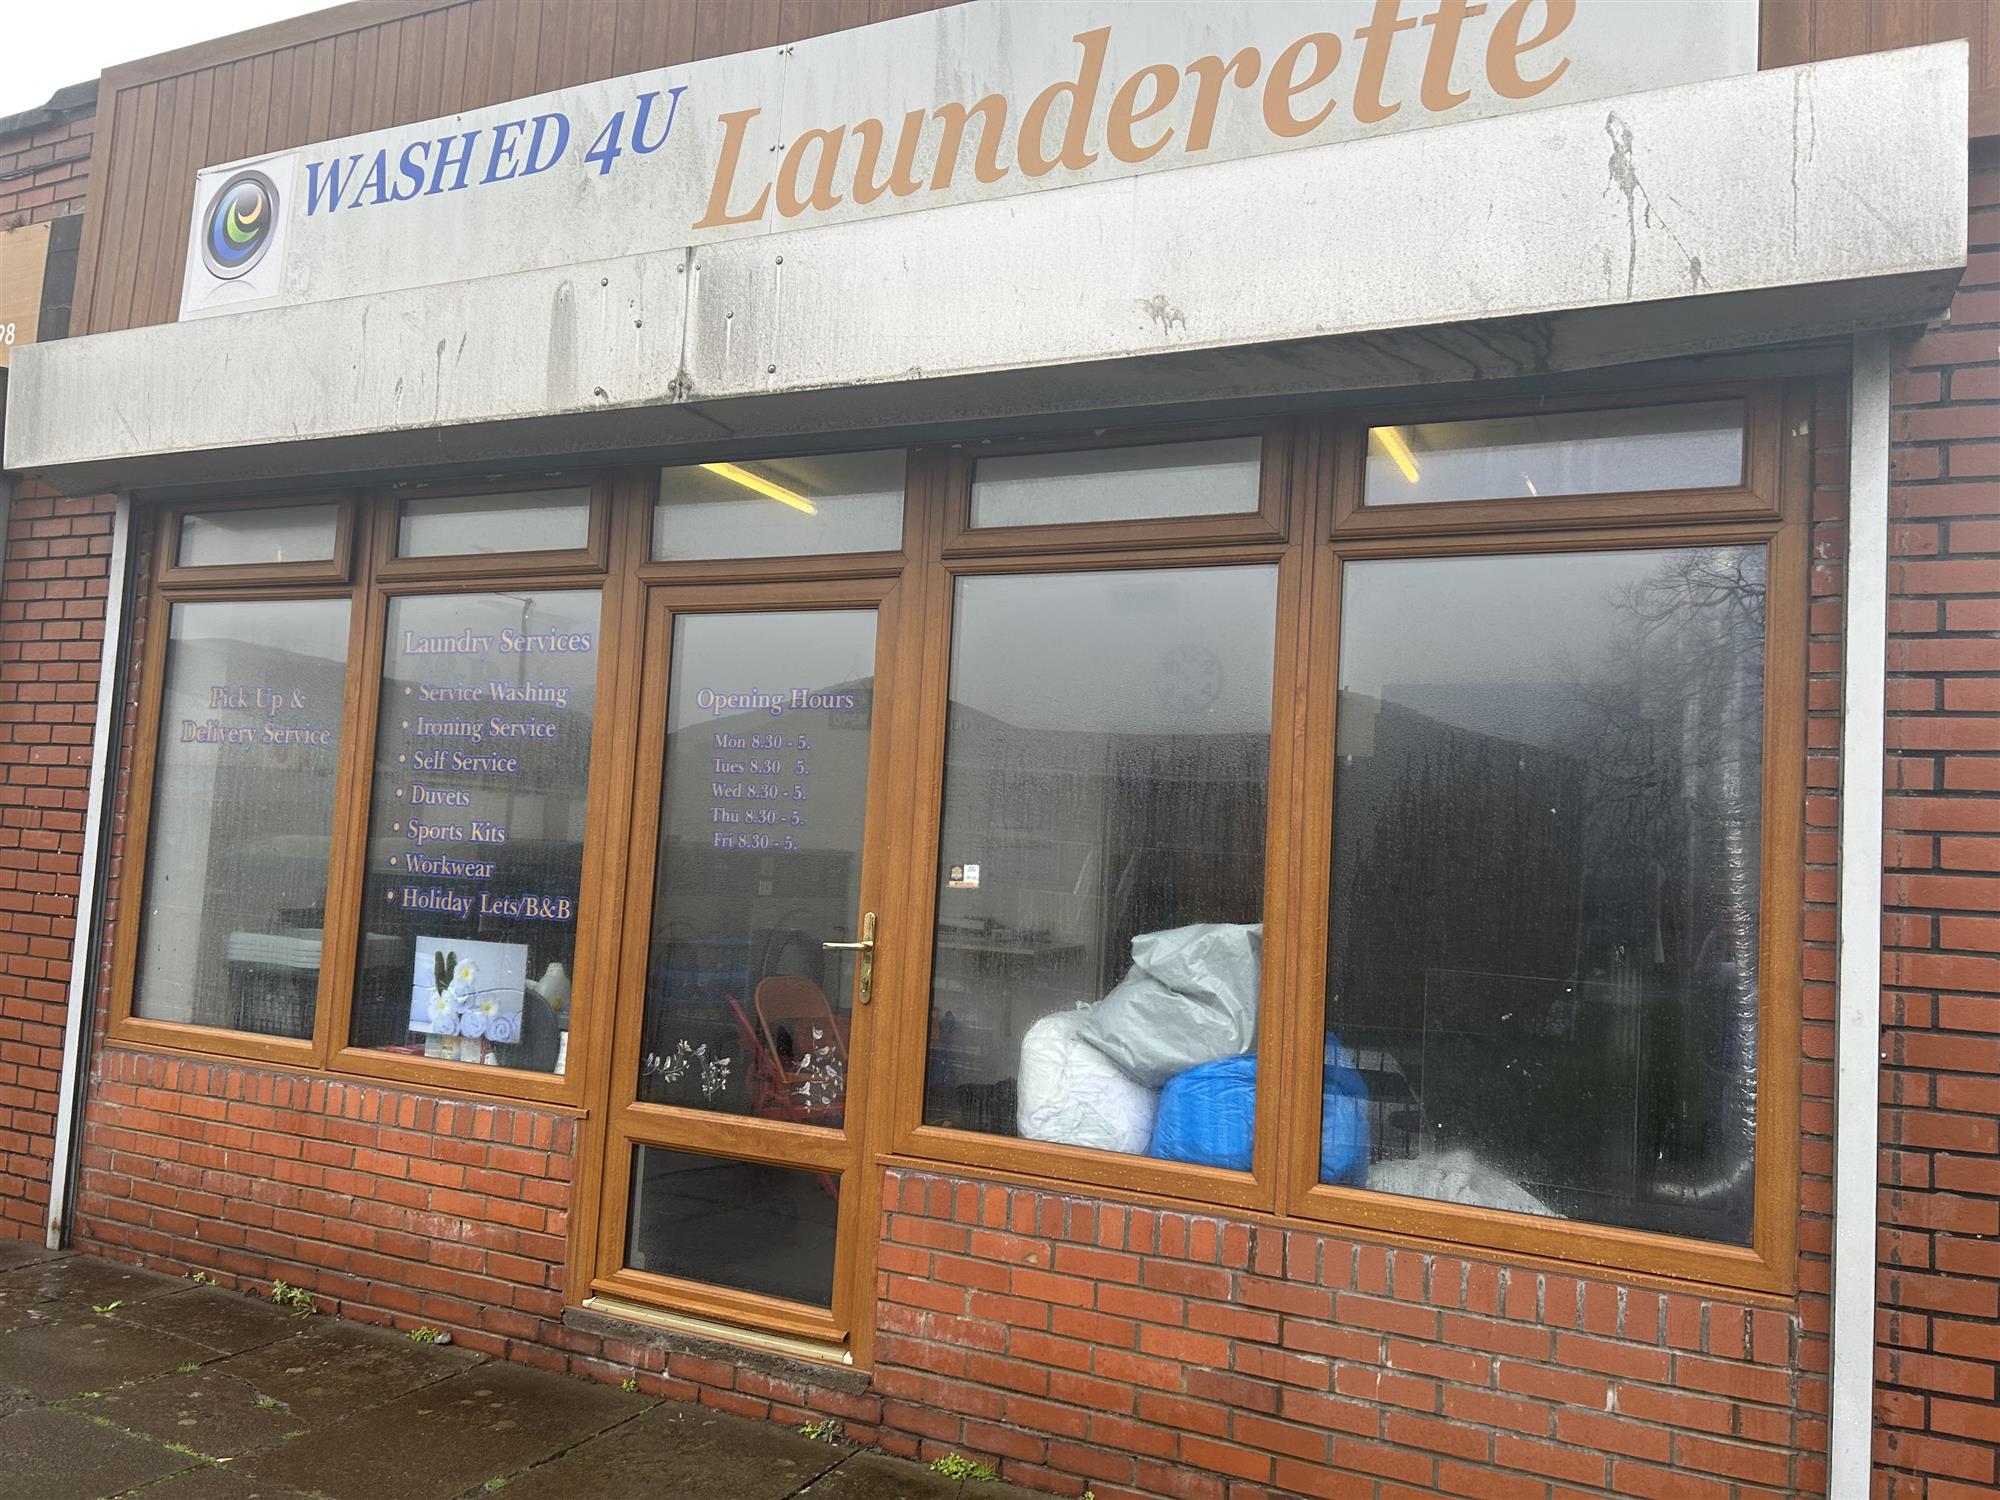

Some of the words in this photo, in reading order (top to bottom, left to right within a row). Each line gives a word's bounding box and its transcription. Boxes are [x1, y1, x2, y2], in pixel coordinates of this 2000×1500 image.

[306, 112, 571, 217] WASHED
[584, 84, 689, 177] 4U
[691, 0, 1577, 230] Launderette
[403, 628, 493, 662] Laundry
[500, 626, 592, 653] Services
[210, 686, 249, 711] Pick
[255, 687, 284, 717] Up
[289, 687, 307, 710] &
[418, 681, 483, 702] Service
[489, 682, 570, 708] Washing
[696, 687, 784, 716] Opening
[789, 687, 856, 709] Hours
[180, 720, 257, 751] Delivery
[262, 722, 332, 747] Service
[414, 715, 484, 743] Ironing
[488, 716, 558, 738] Service
[713, 733, 746, 749] Mon
[751, 733, 783, 750] 8.30
[412, 750, 448, 771] Self
[450, 752, 518, 774] Service
[711, 758, 745, 774] Tues
[749, 758, 781, 775] 8.30
[410, 784, 471, 806] Duvets
[711, 782, 742, 799] Wed
[746, 784, 779, 800] 8.30
[710, 807, 740, 823] Thu
[744, 808, 777, 825] 8.30
[406, 819, 464, 846] Sports
[470, 822, 506, 843] Kits
[713, 832, 734, 848] Fri
[737, 832, 770, 850] 8.30
[404, 854, 495, 880] Workwear
[402, 888, 474, 919] Holiday
[480, 893, 572, 919] Lets/B&B
